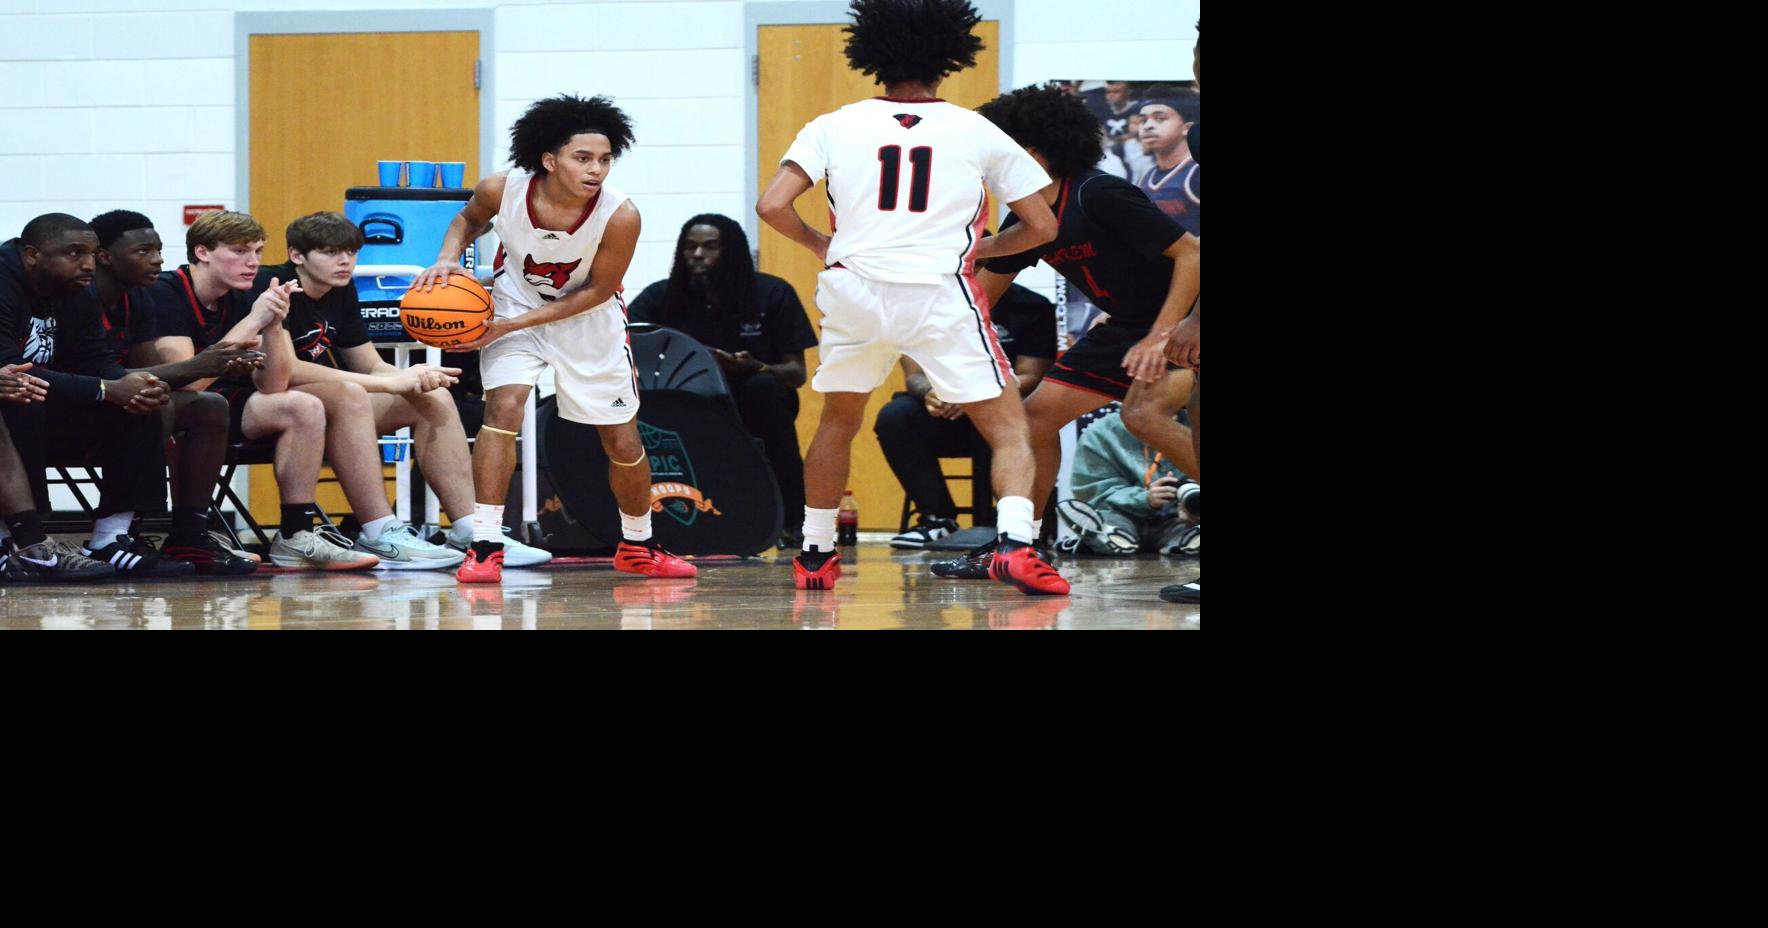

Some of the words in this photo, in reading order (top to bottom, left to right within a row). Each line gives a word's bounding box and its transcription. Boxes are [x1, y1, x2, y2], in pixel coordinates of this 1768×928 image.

[878, 144, 933, 213] 11
[465, 243, 475, 274] ER
[360, 307, 400, 318] ERAD
[406, 314, 465, 330] Wilson
[650, 455, 681, 471] PIC
